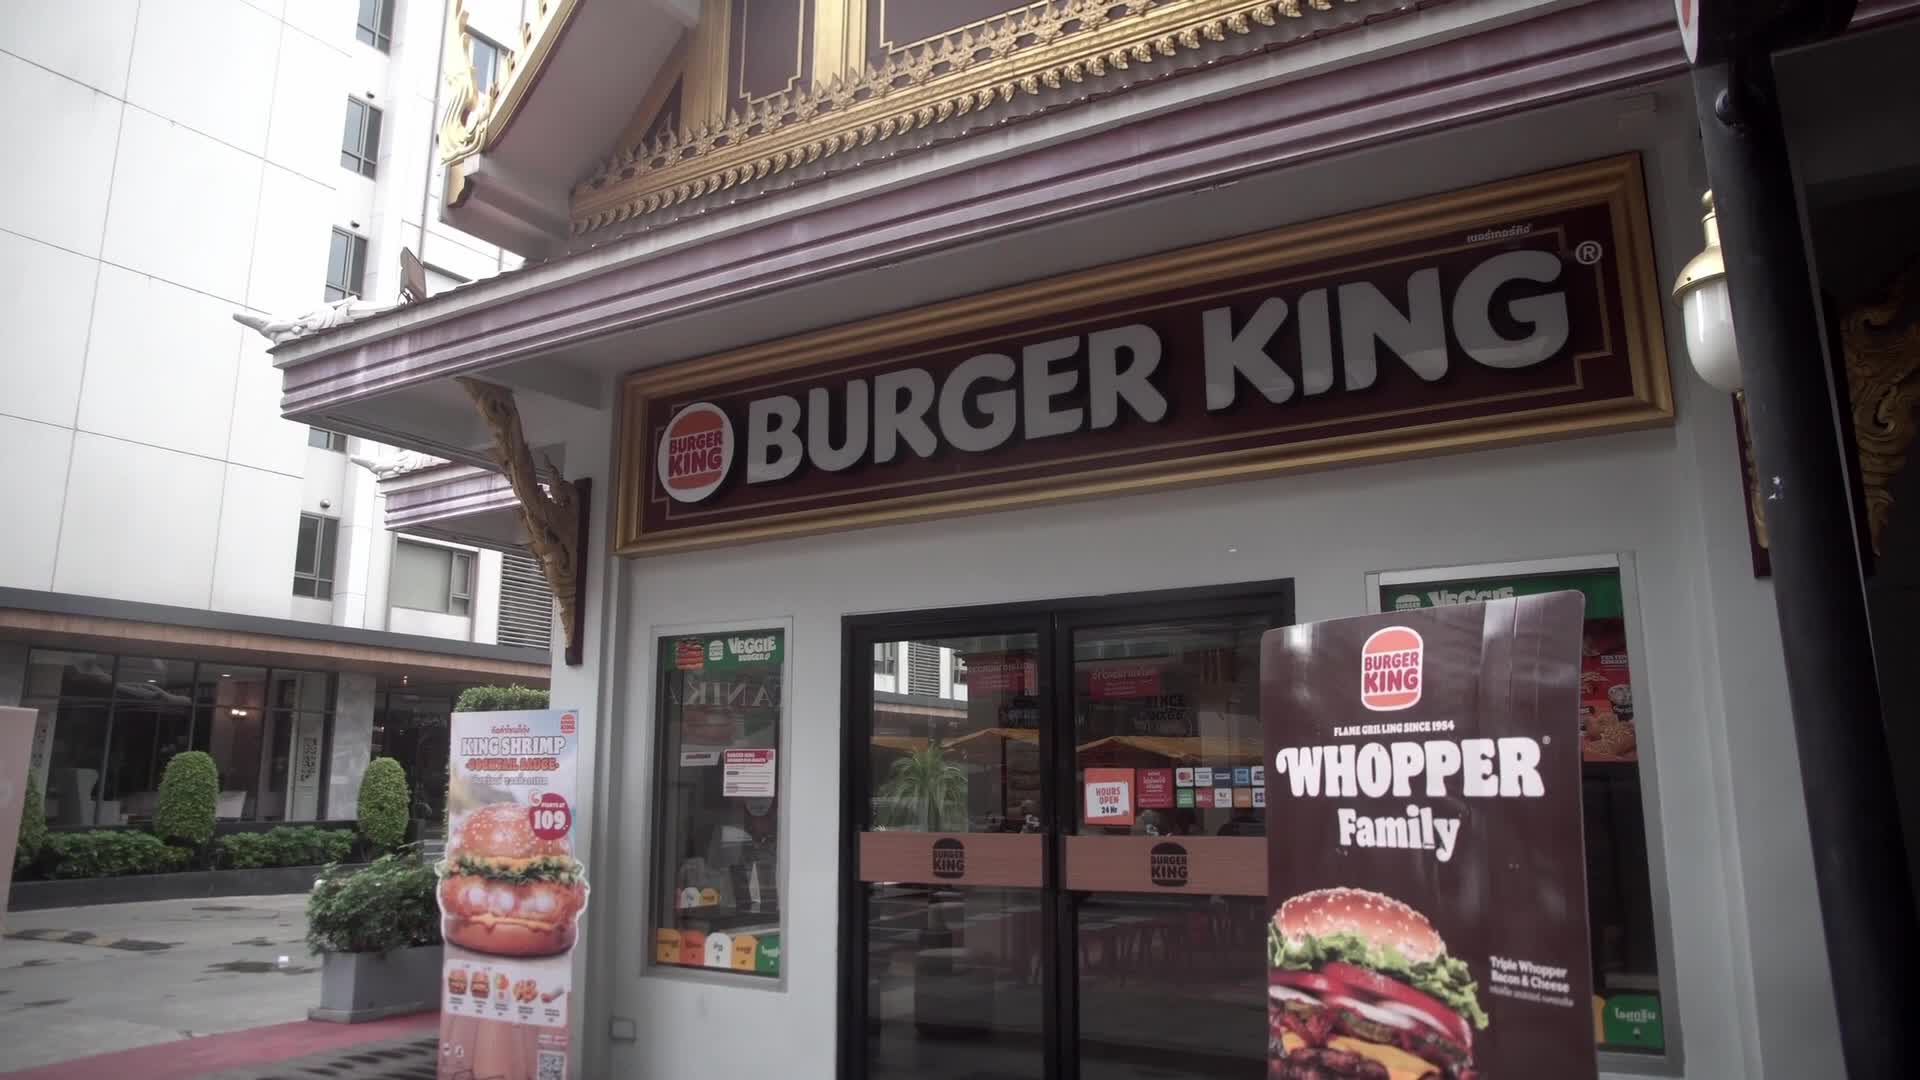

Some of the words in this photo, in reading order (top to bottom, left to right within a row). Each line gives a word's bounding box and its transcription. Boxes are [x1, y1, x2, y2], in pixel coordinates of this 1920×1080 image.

[747, 324, 1168, 484] BURGER
[1202, 250, 1569, 410] KING
[669, 431, 723, 454] BURGER
[668, 447, 722, 477] KING
[727, 636, 776, 654] VEGGIE
[1364, 651, 1419, 671] BURGER
[1363, 668, 1419, 693] KING
[1334, 726, 1361, 736] FLAME
[1404, 722, 1431, 733] SINCE
[1432, 720, 1455, 731] 1954
[461, 737, 499, 756] KING
[501, 736, 566, 756] SHRIMP
[1276, 737, 1545, 798] WHOPPER
[1096, 786, 1121, 796] HOURS
[1099, 796, 1119, 804] OPEN
[1338, 804, 1460, 862] Family
[933, 859, 965, 873] KING
[1151, 856, 1187, 865] BURGER
[1151, 865, 1188, 879] KING
[1489, 956, 1517, 972] Triple
[1518, 959, 1567, 979] Whopper
[1491, 970, 1521, 985] Bacon
[1530, 978, 1570, 993] Cheese
